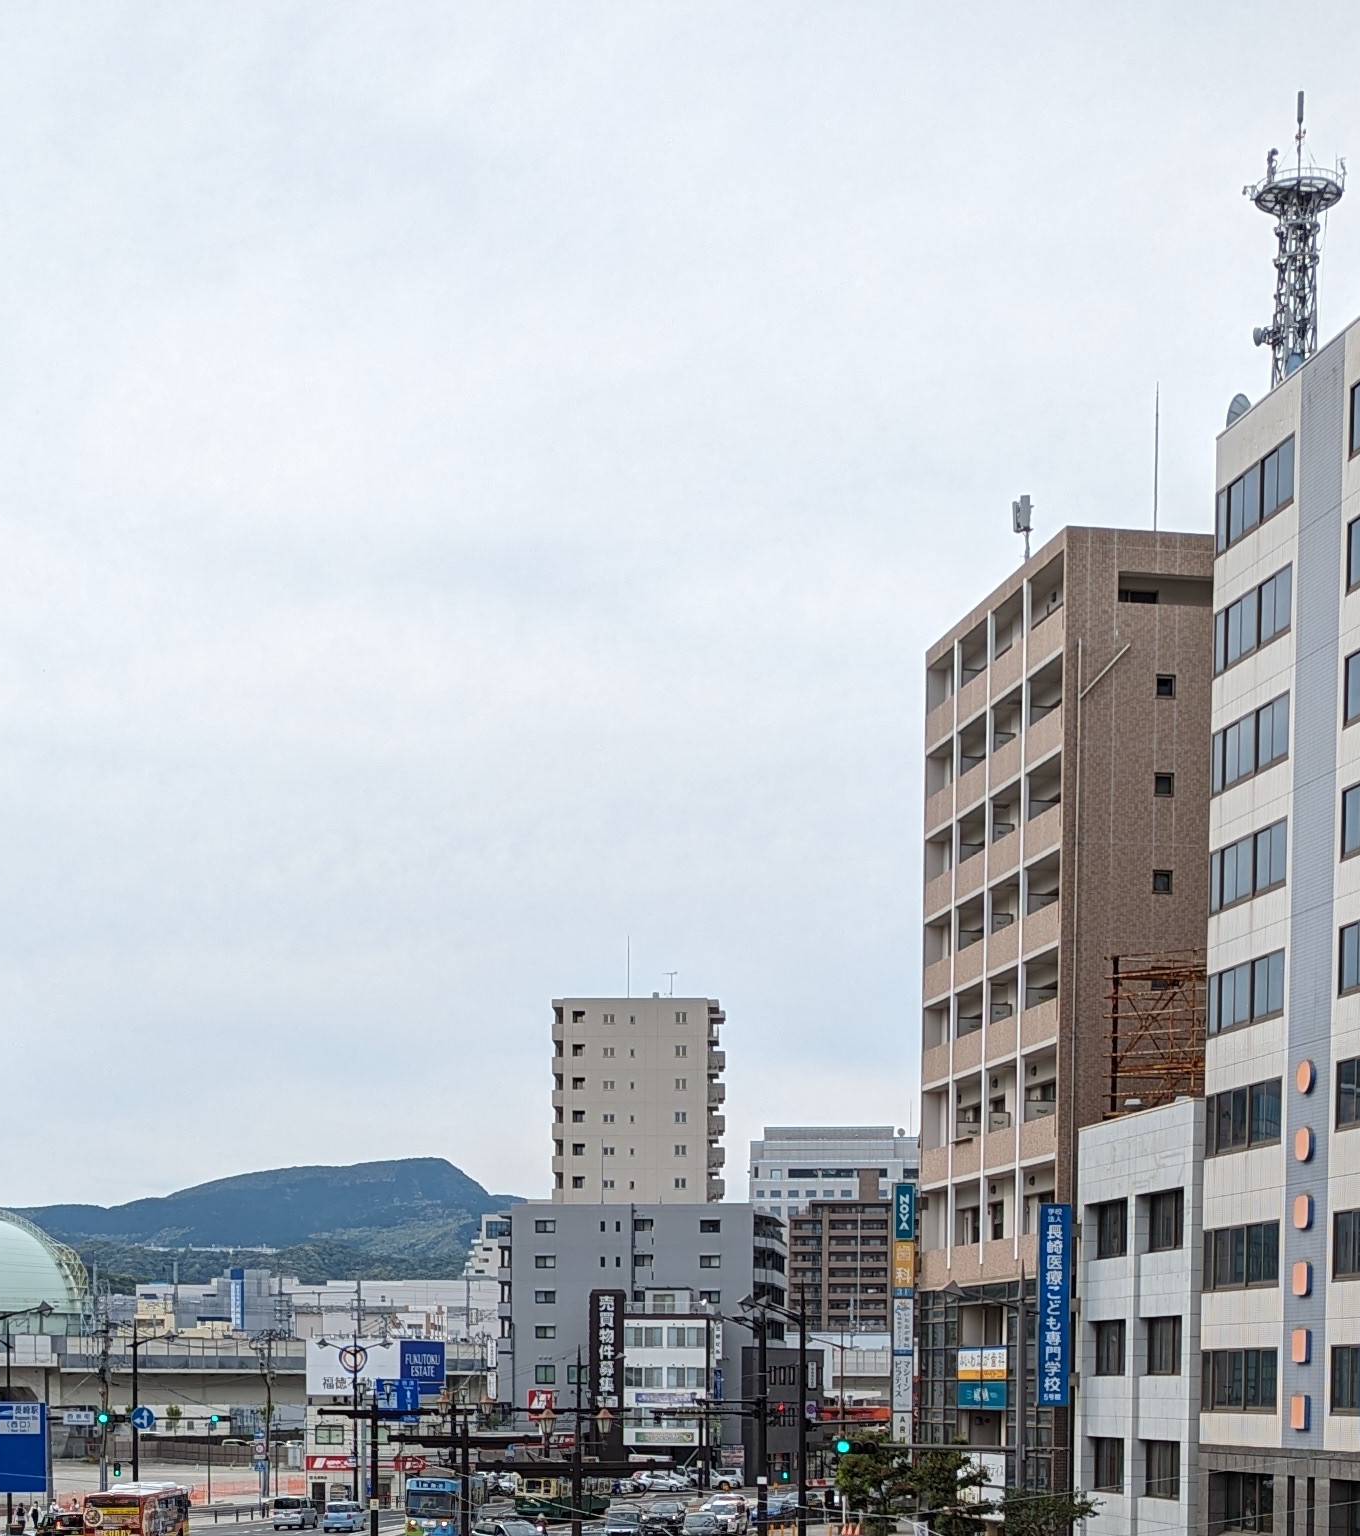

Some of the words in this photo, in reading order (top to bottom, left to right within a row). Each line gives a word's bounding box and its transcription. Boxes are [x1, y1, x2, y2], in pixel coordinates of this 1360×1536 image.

[898, 1193, 911, 1232] NOVA
[895, 1244, 912, 1284] 歯科
[1044, 1224, 1064, 1392] 長崎医療こども専門学校
[404, 1353, 441, 1367] FUKUTOKU
[598, 1294, 616, 1393] 売買物件募集
[410, 1365, 436, 1378] ESTATE
